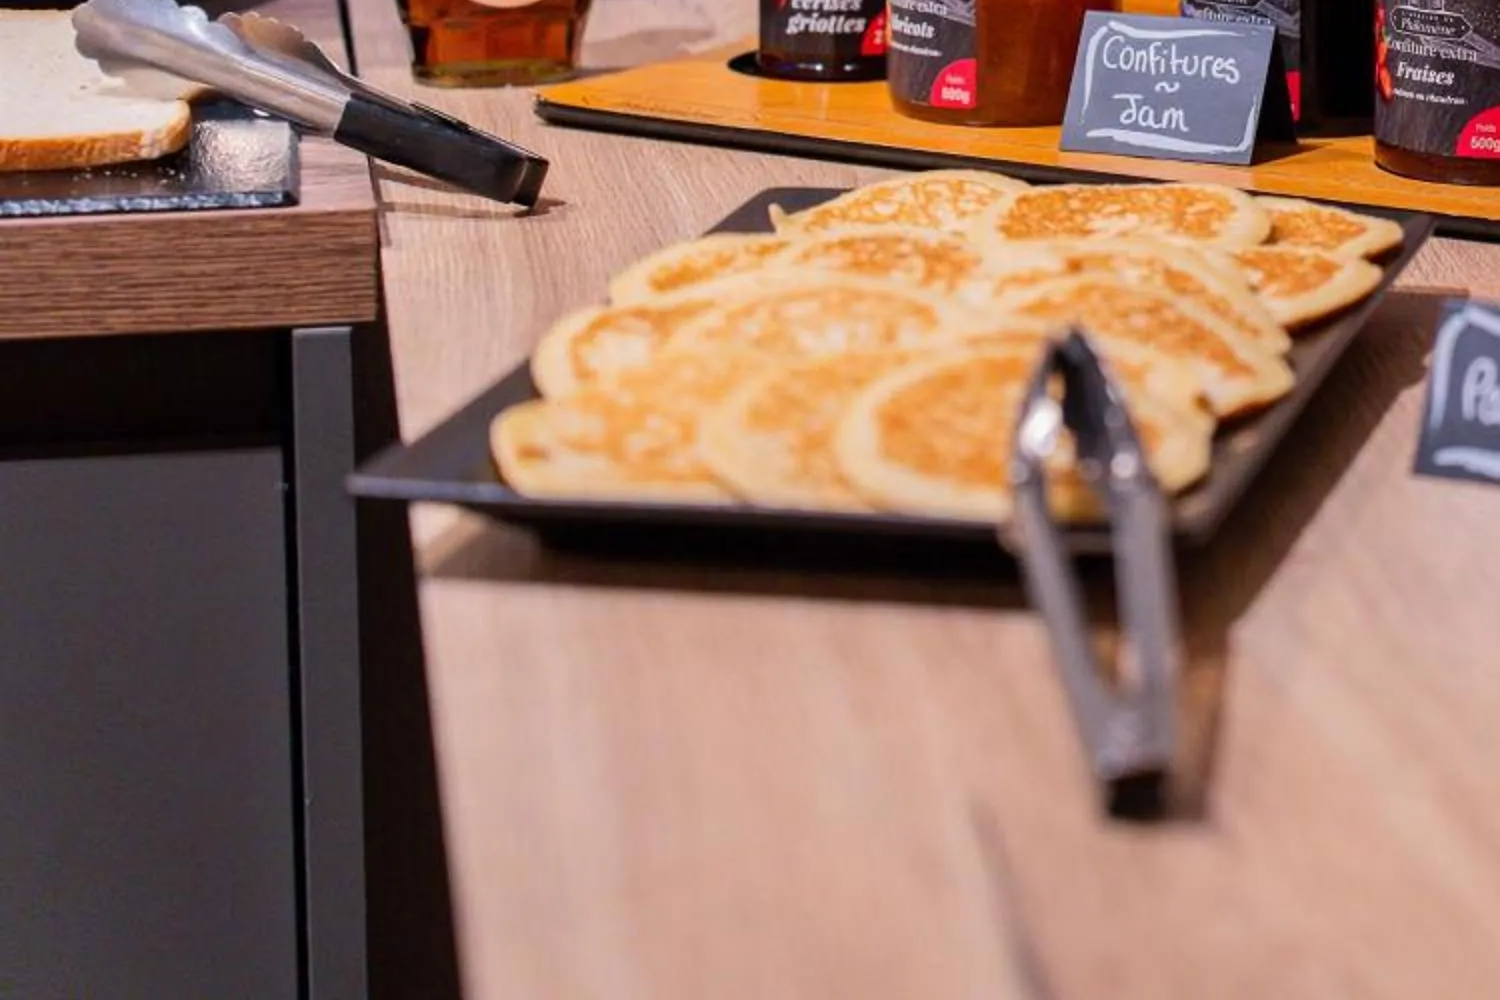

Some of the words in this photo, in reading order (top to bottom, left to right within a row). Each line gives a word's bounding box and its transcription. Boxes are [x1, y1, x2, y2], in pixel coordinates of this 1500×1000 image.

[785, 12, 867, 36] griottes
[1102, 35, 1241, 85] Confitures
[1396, 61, 1456, 86] Fraises
[1111, 93, 1190, 132] Jam
